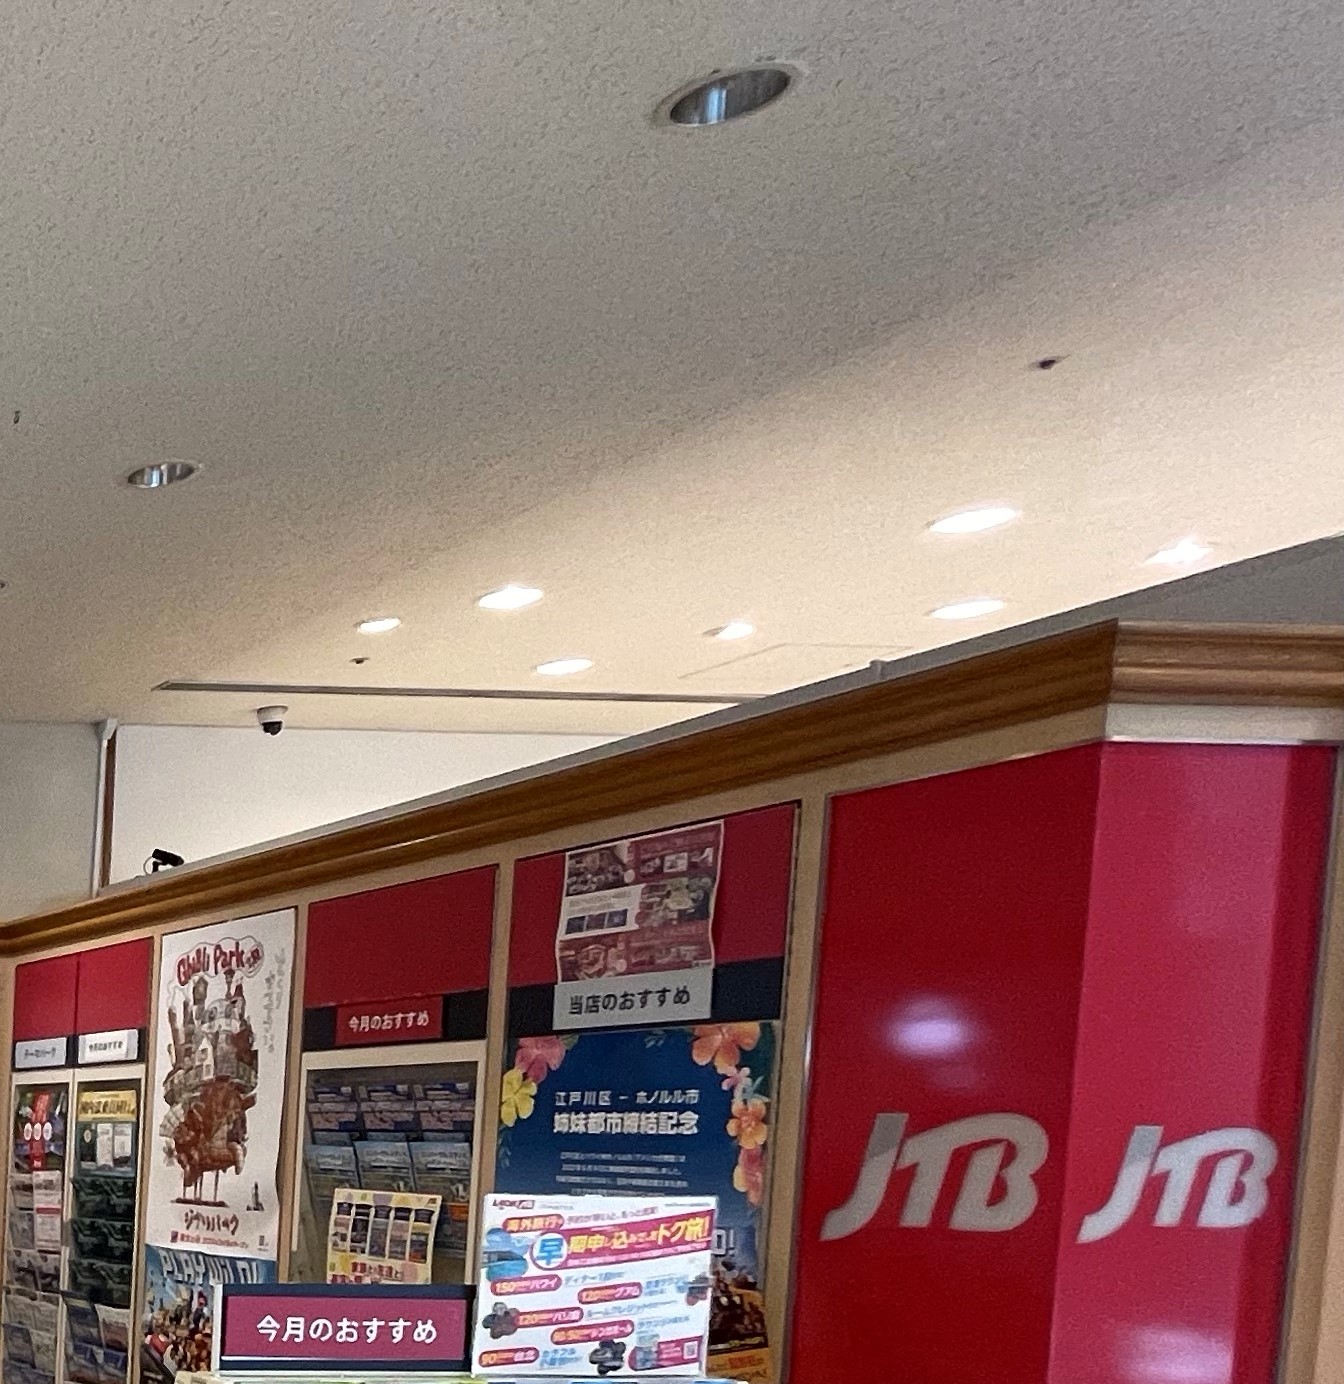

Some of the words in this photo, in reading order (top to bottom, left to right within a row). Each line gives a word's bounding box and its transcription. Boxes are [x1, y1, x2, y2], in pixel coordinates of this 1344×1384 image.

[568, 986, 691, 1015] 当店のおすすめ
[348, 1010, 430, 1033] 今月のおすすめ
[554, 1091, 611, 1106] 江戸川区
[636, 1089, 700, 1105] ホノルル市
[819, 1112, 1049, 1241] JTB
[1076, 1125, 1278, 1244] JTB
[256, 1315, 438, 1345] 今月のおすすめ
